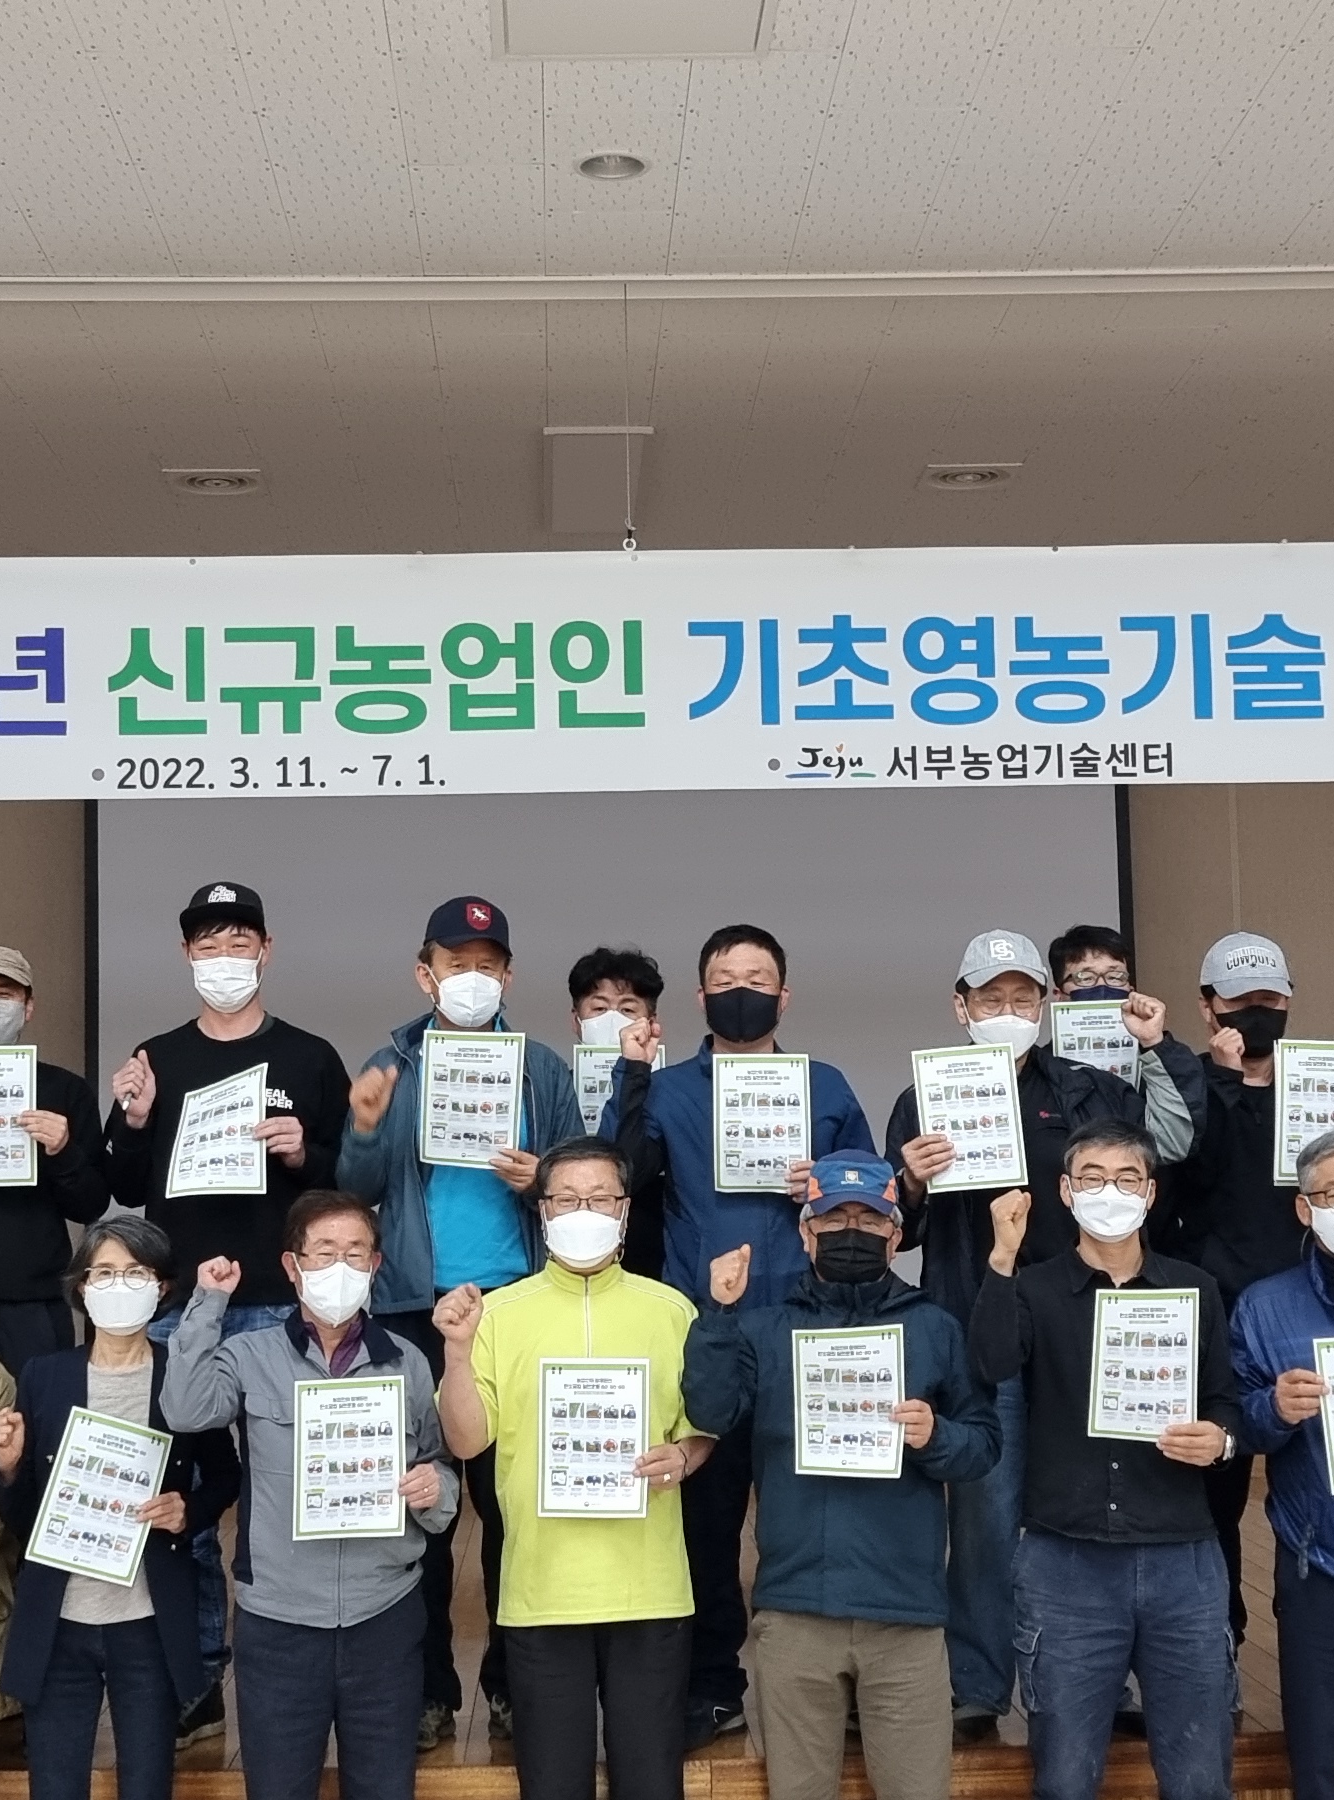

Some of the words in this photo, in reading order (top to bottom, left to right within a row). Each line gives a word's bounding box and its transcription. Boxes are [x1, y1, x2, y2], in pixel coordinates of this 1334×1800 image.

[108, 623, 645, 735] 신규농업인
[688, 612, 1326, 725] 기초영농기술
[116, 758, 214, 790] 2022.
[230, 757, 258, 789] 3.
[276, 757, 326, 788] 11.
[372, 755, 402, 786] 7.
[418, 755, 445, 786] 1.
[797, 744, 864, 778] Jeju
[886, 743, 1175, 780] 서부농업기술센터
[265, 1088, 288, 1100] EAL
[267, 1097, 294, 1110] DER
